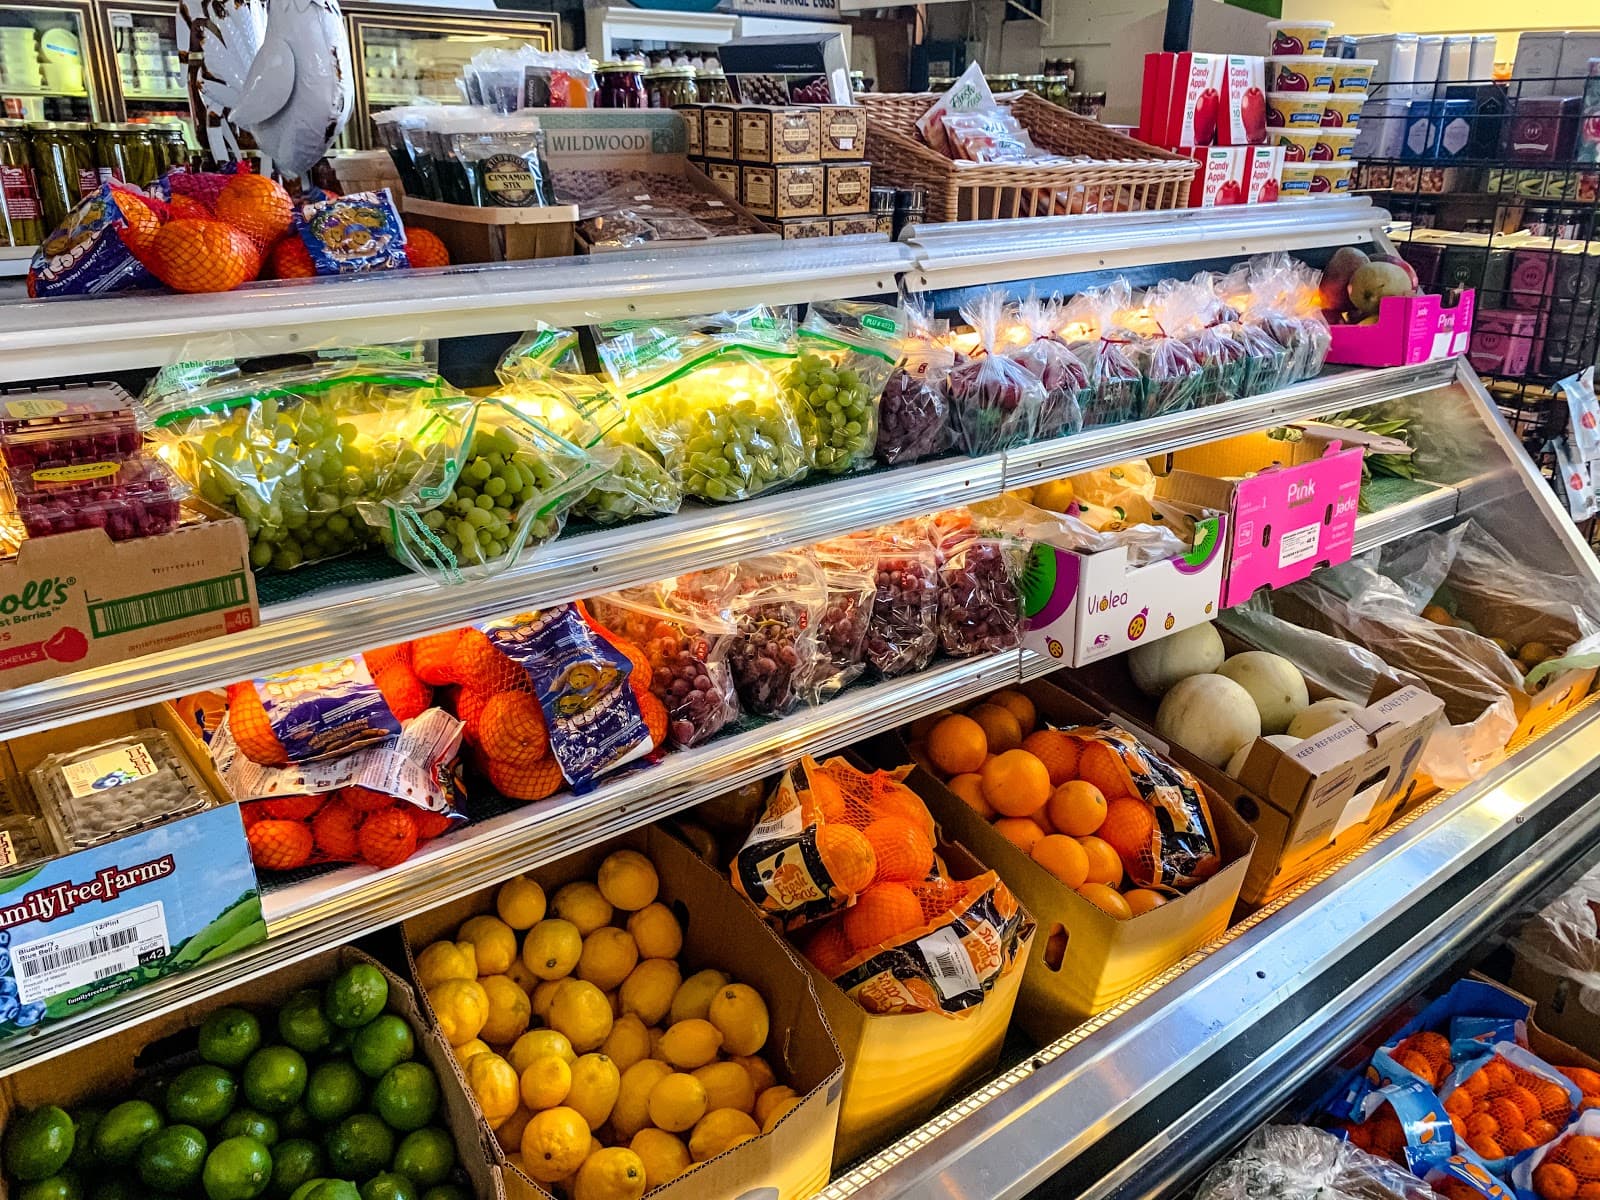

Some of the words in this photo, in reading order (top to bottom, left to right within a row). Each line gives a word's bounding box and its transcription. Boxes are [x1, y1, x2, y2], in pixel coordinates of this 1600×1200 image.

[552, 135, 645, 151] WILDWOOD
[1209, 161, 1229, 172] Candy
[488, 174, 530, 182] CINNAMON
[1288, 478, 1316, 502] Pink
[235, 612, 250, 625] 46
[1295, 744, 1314, 760] KEEP
[18, 941, 54, 955] Blueberry
[20, 952, 37, 961] Blue
